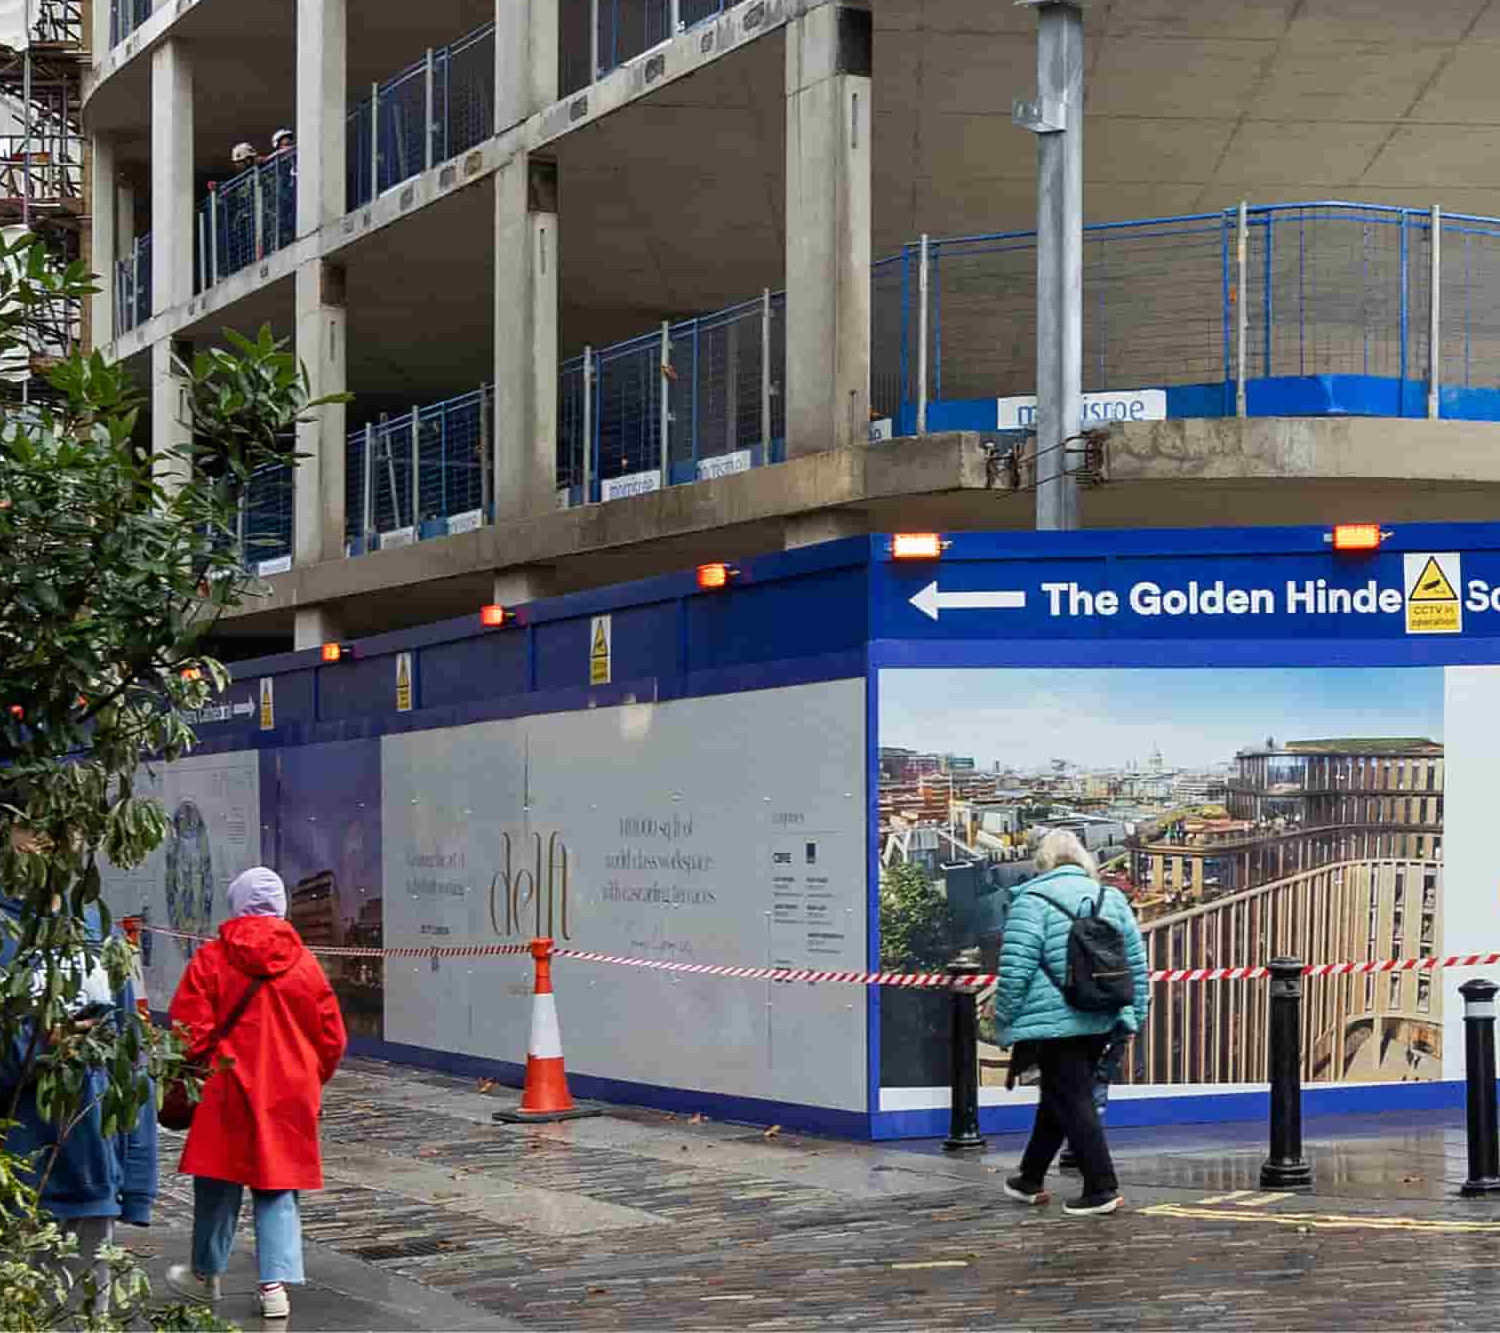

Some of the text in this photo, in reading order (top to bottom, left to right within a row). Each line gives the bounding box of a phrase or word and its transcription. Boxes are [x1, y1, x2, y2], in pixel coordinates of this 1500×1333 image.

[1018, 396, 1146, 427] misroe
[1041, 579, 1403, 617] The Golden Hinde
[1412, 605, 1443, 615] CCTV
